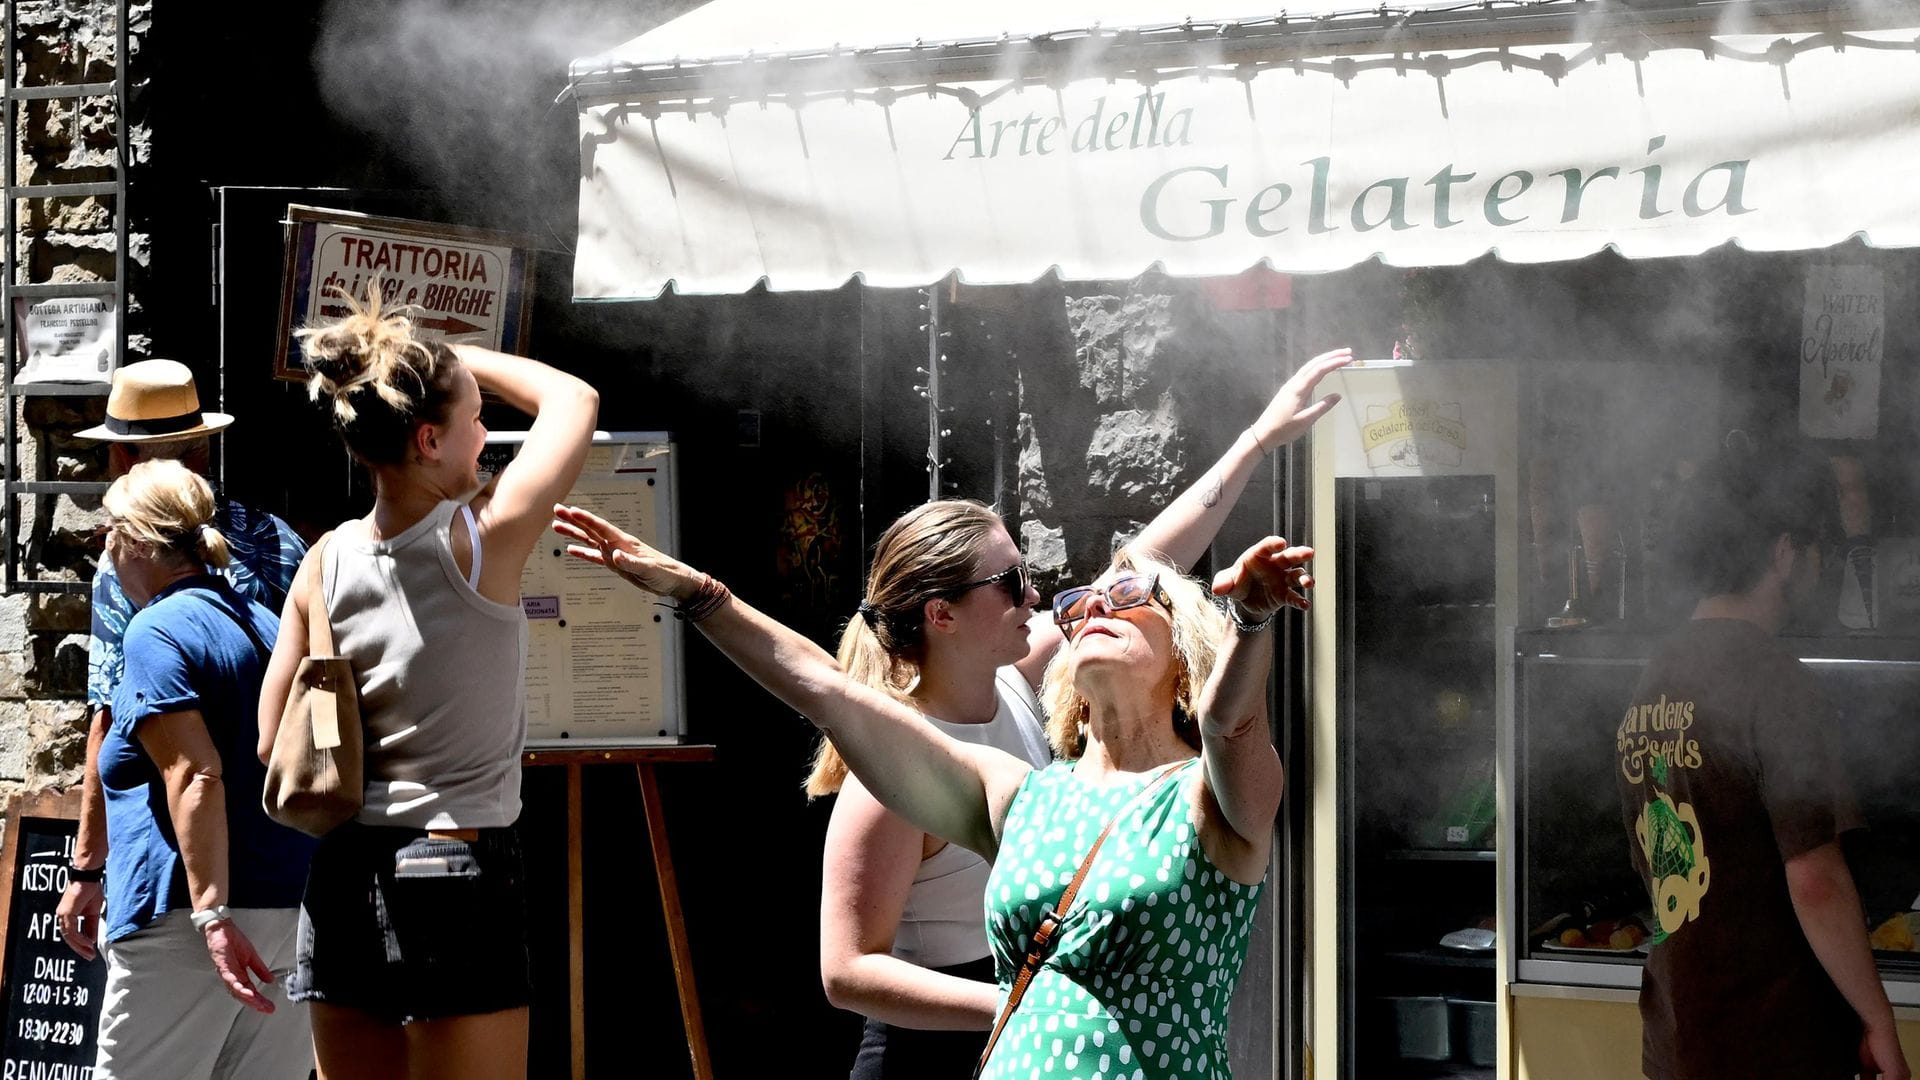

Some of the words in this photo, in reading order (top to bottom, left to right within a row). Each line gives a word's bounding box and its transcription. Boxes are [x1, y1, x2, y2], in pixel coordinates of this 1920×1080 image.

[942, 106, 1061, 160] Arte
[1071, 91, 1194, 154] della
[1139, 134, 1758, 242] Gelateria
[341, 237, 488, 283] TRATTORIA
[29, 304, 62, 315] BOTTEGA
[63, 302, 107, 314] ARTIGIANA
[321, 271, 346, 298] da
[406, 287, 418, 306] e
[423, 283, 496, 317] BIRGHE
[1822, 294, 1879, 314] WATER
[1369, 417, 1415, 442] Gelateria
[1649, 730, 1702, 769] seeds
[22, 863, 68, 893] RISTO
[34, 956, 76, 982] DALLE
